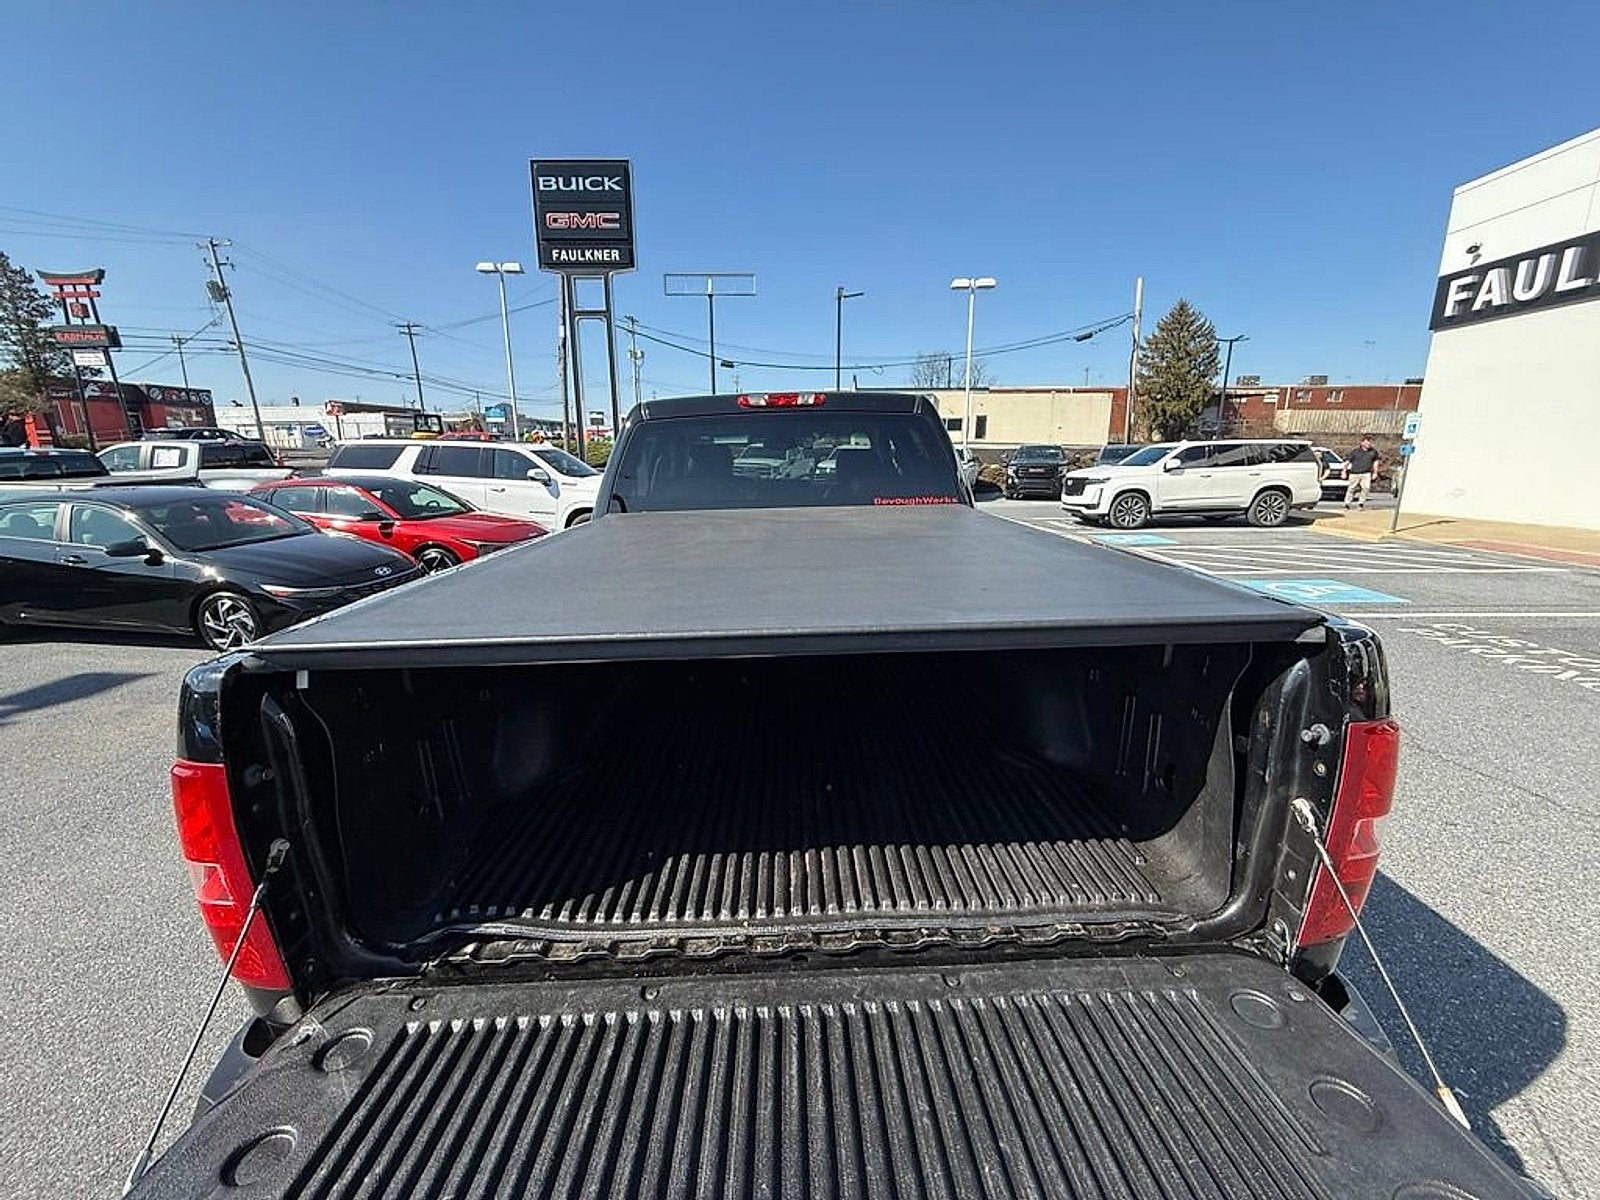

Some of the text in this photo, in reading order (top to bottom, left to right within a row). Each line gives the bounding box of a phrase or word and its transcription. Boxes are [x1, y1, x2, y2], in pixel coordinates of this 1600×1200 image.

[538, 176, 623, 191] BUICK
[546, 212, 620, 229] GMC
[552, 249, 620, 261] FAULKNER
[1444, 246, 1600, 317] FAUL
[1432, 623, 1600, 672] CUSTO
